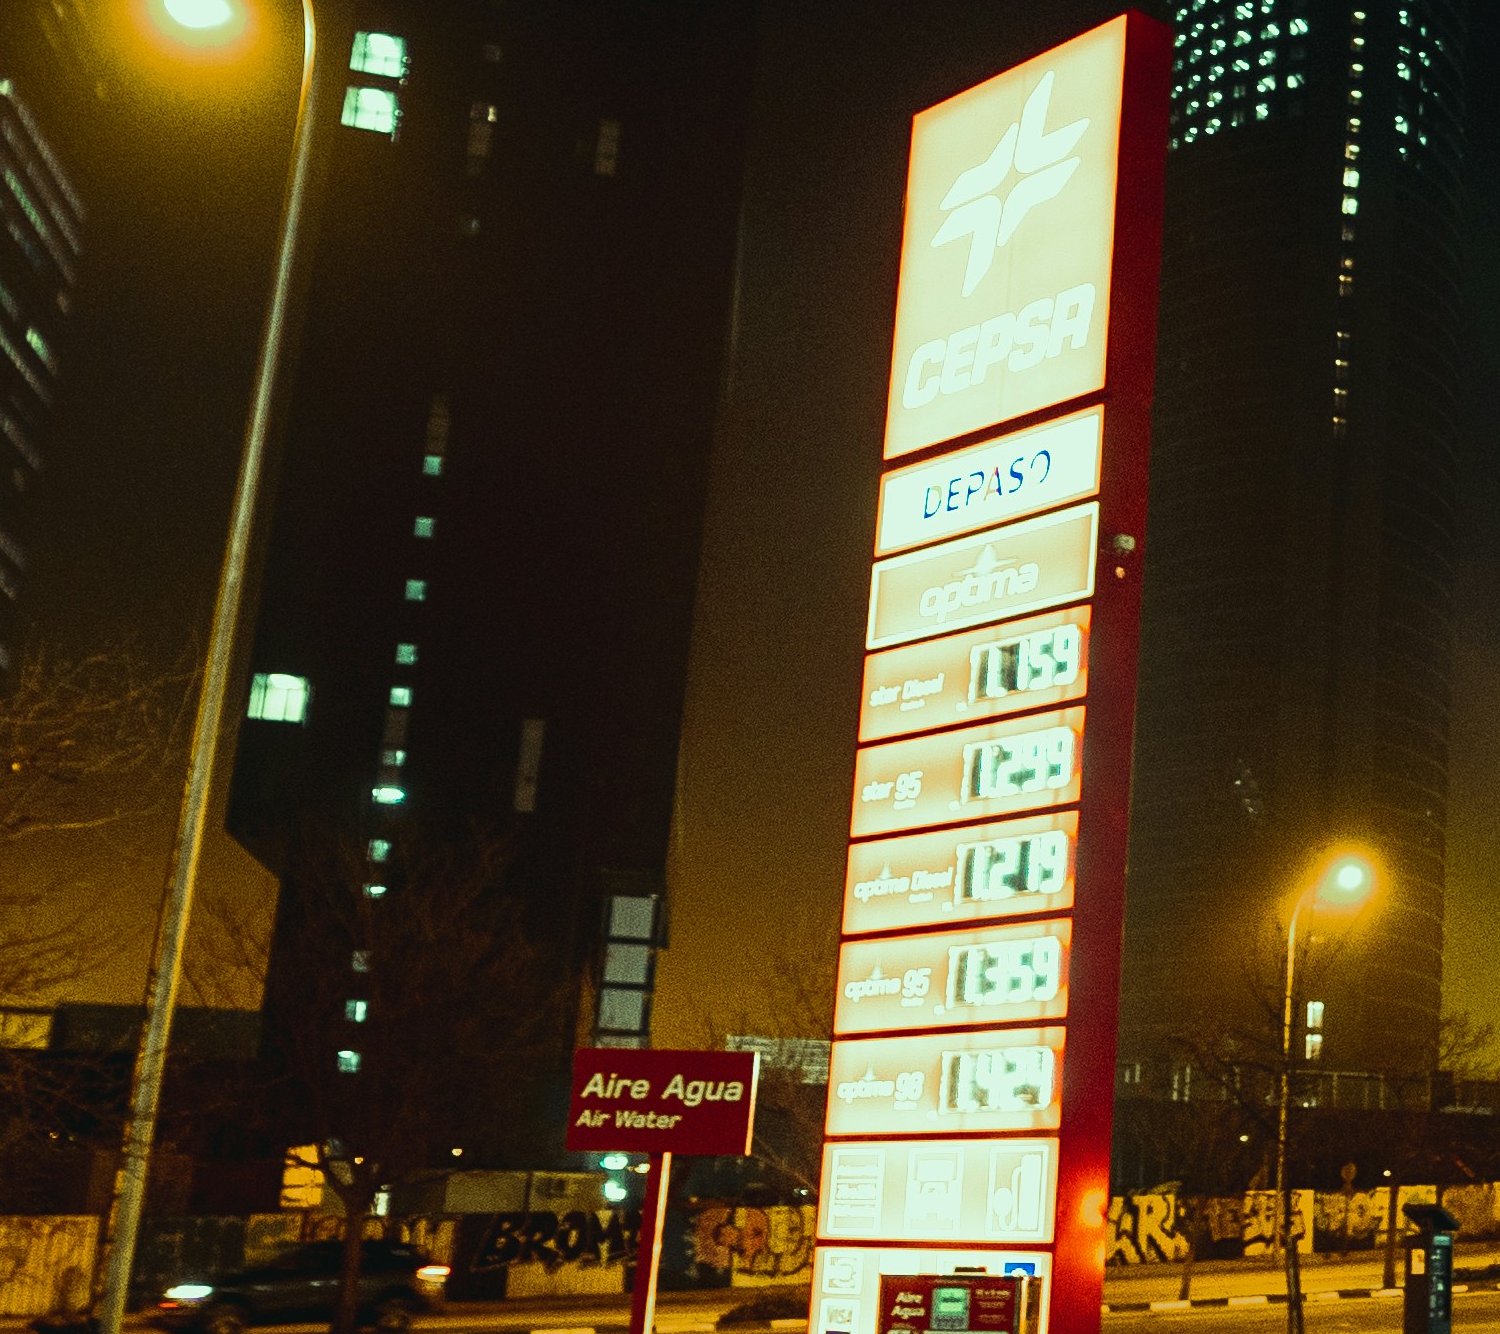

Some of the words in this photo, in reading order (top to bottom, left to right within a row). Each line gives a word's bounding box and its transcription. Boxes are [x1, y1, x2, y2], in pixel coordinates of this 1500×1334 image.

[903, 283, 1096, 410] CEPSA
[924, 450, 1051, 519] DEPASO
[919, 563, 1039, 623] optima
[894, 770, 923, 801] 95
[902, 967, 932, 998] 95
[581, 1072, 650, 1100] Aire
[661, 1074, 744, 1107] Agua
[576, 1109, 611, 1128] Air
[615, 1110, 683, 1130] Water
[891, 1305, 926, 1320] Agua
[895, 1291, 924, 1304] Aire
